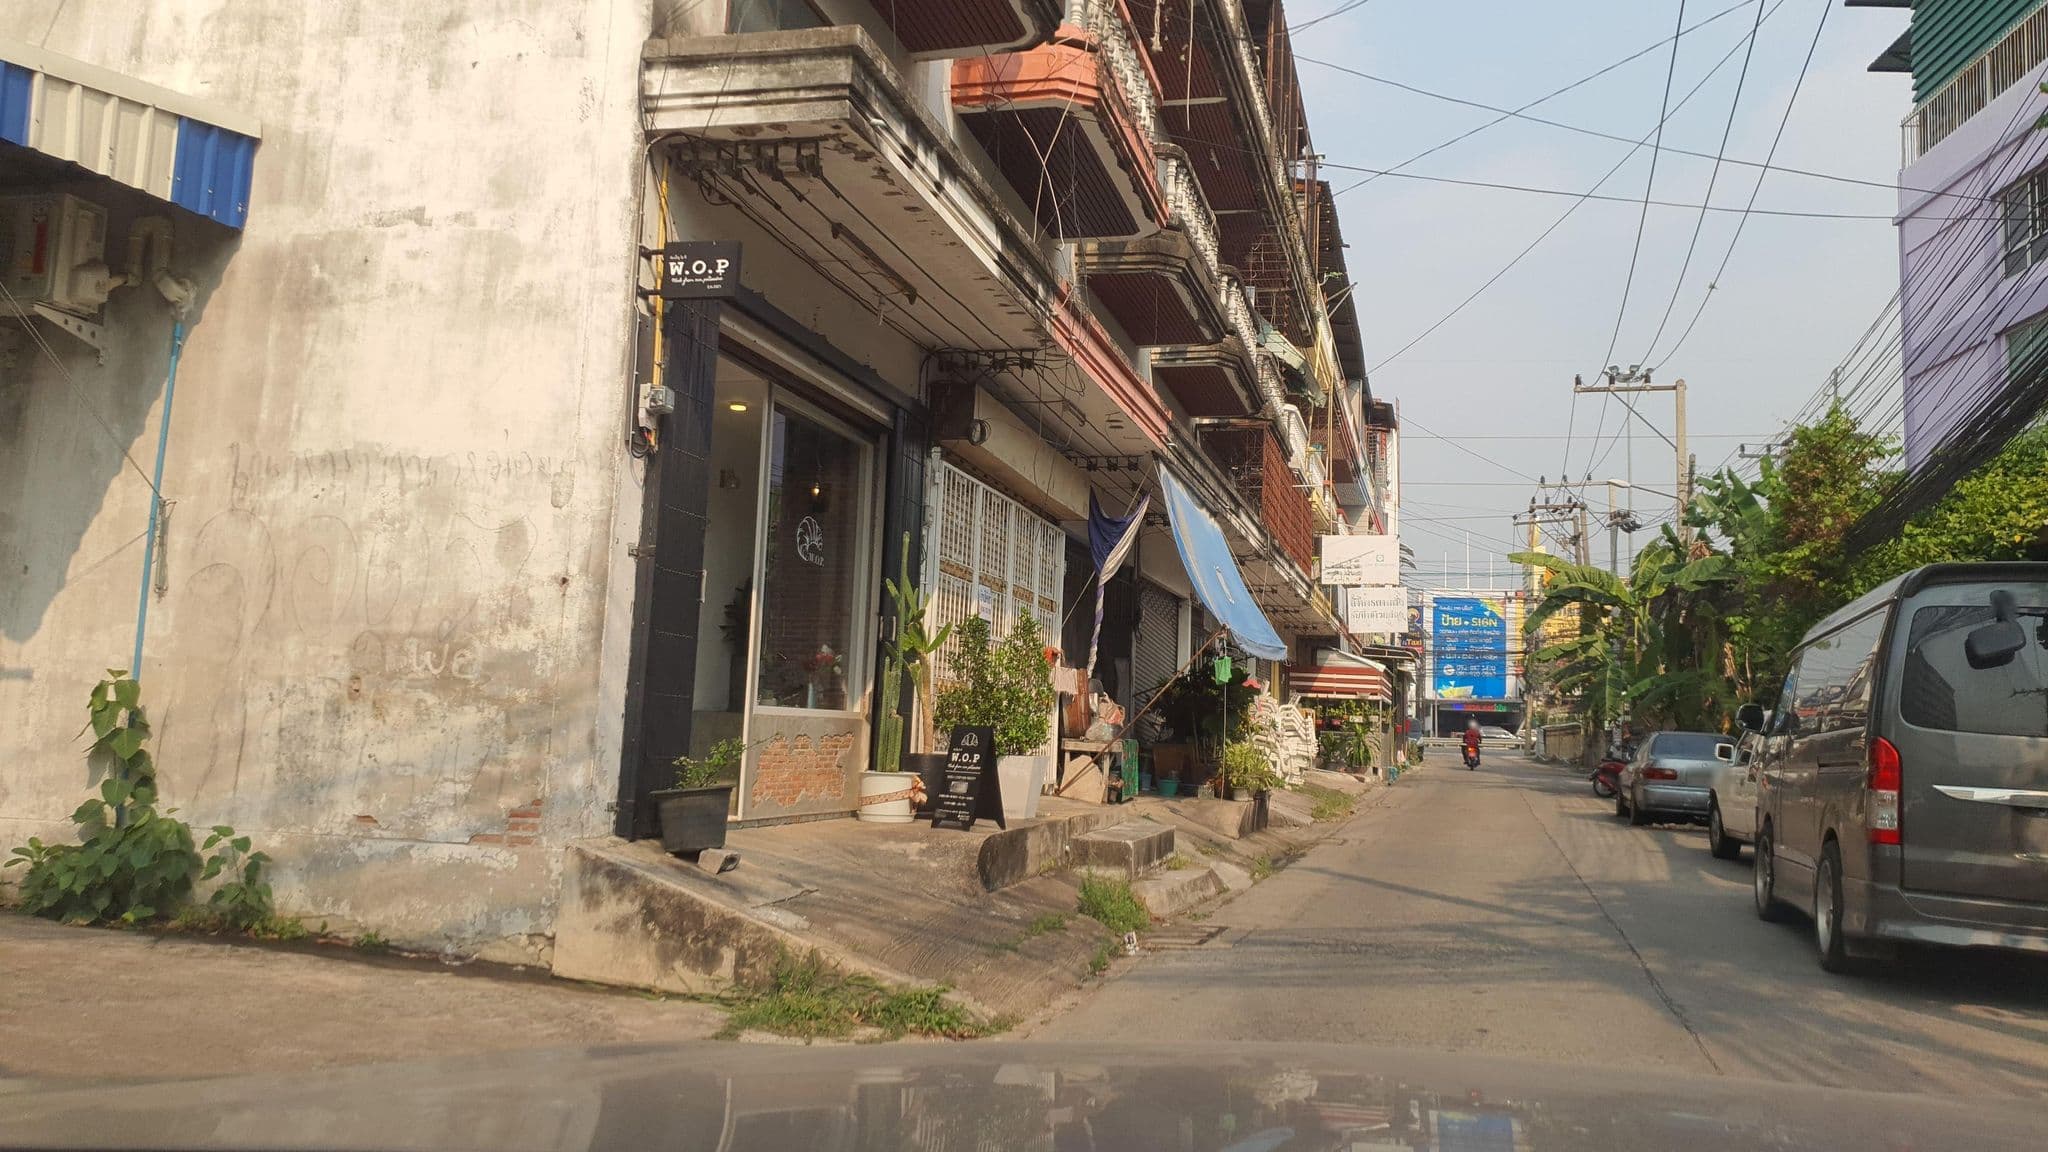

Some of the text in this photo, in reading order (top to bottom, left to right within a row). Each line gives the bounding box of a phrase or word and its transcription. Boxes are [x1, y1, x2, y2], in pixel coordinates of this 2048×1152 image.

[668, 259, 730, 276] W.O.P
[1441, 614, 1498, 627] ป้าย SIGN
[951, 752, 981, 763] W.O.P
